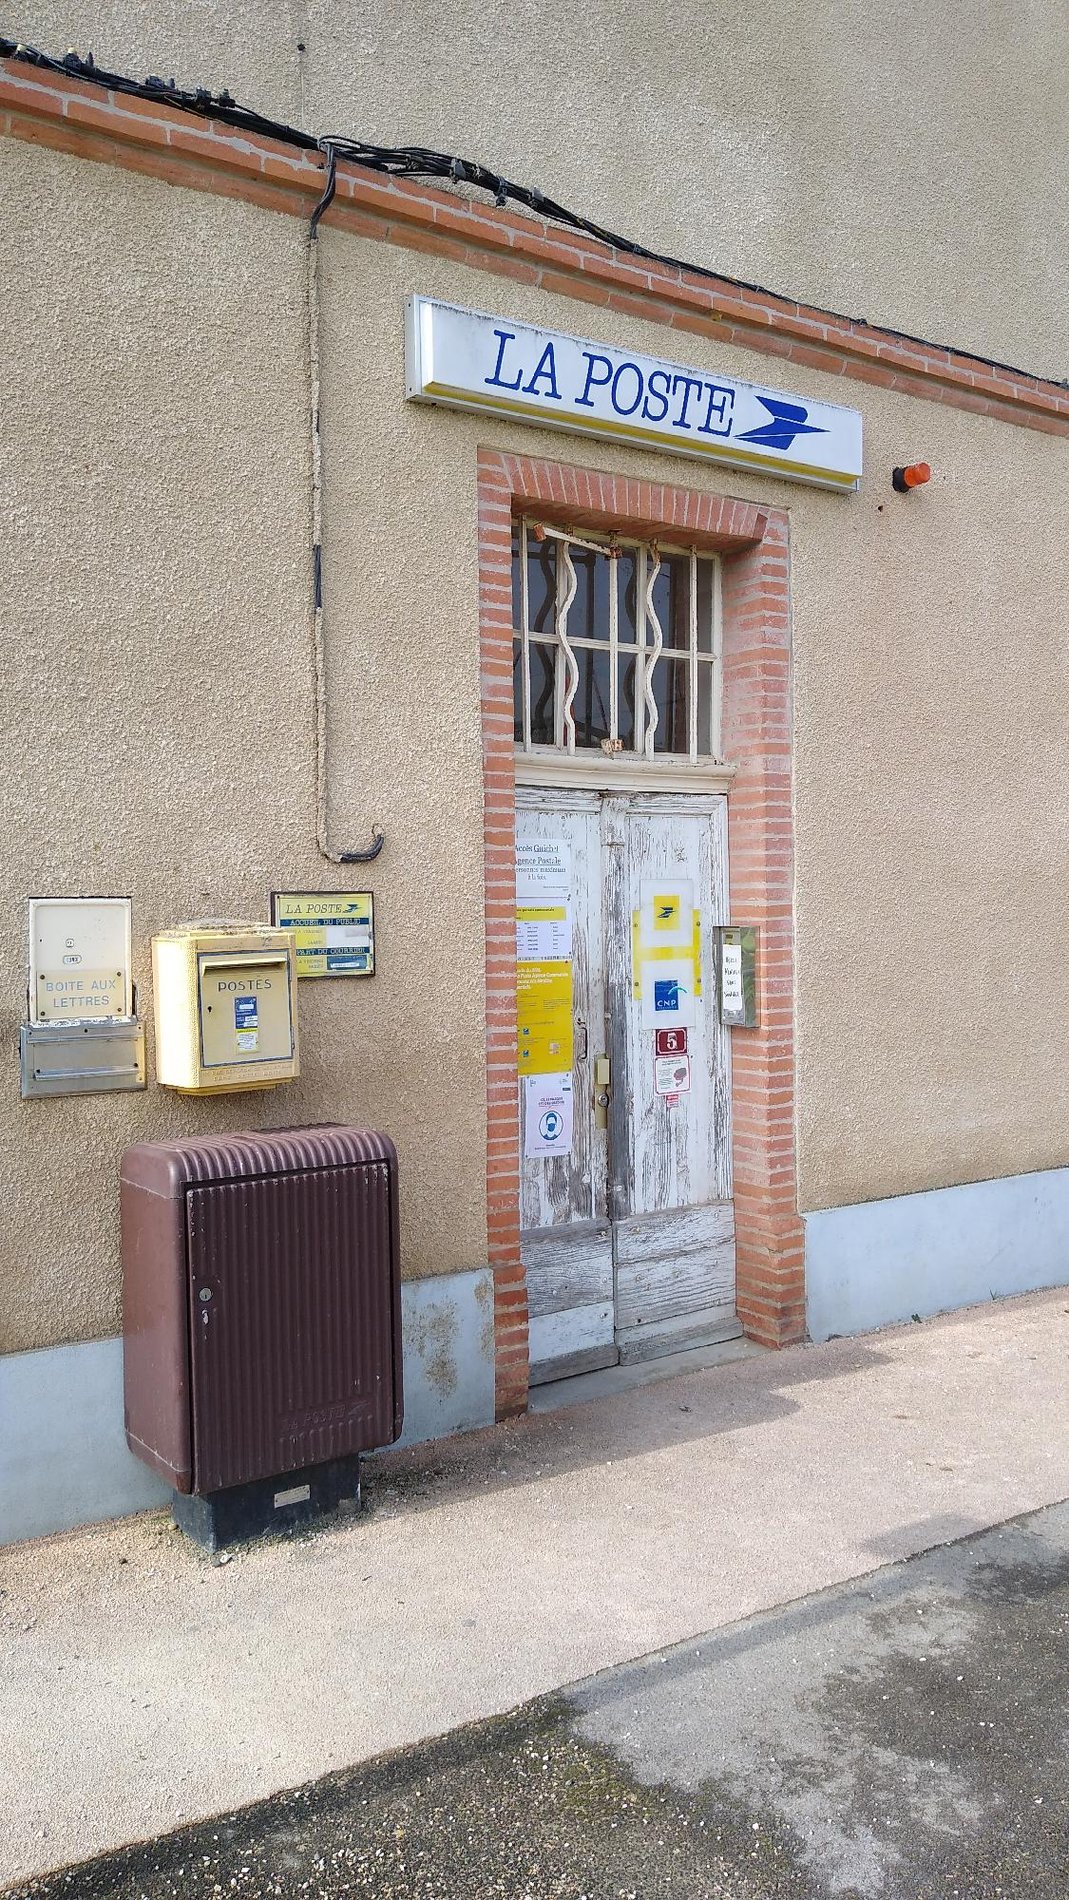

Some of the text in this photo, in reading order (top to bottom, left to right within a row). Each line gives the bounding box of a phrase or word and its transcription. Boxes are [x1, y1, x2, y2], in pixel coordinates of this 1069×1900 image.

[484, 328, 736, 438] LA POSTE
[285, 903, 342, 914] LA POSTE
[46, 979, 116, 992] BOITE AUX
[218, 978, 272, 992] POSTES
[53, 995, 110, 1008] LETTRES
[666, 1032, 678, 1050] 5
